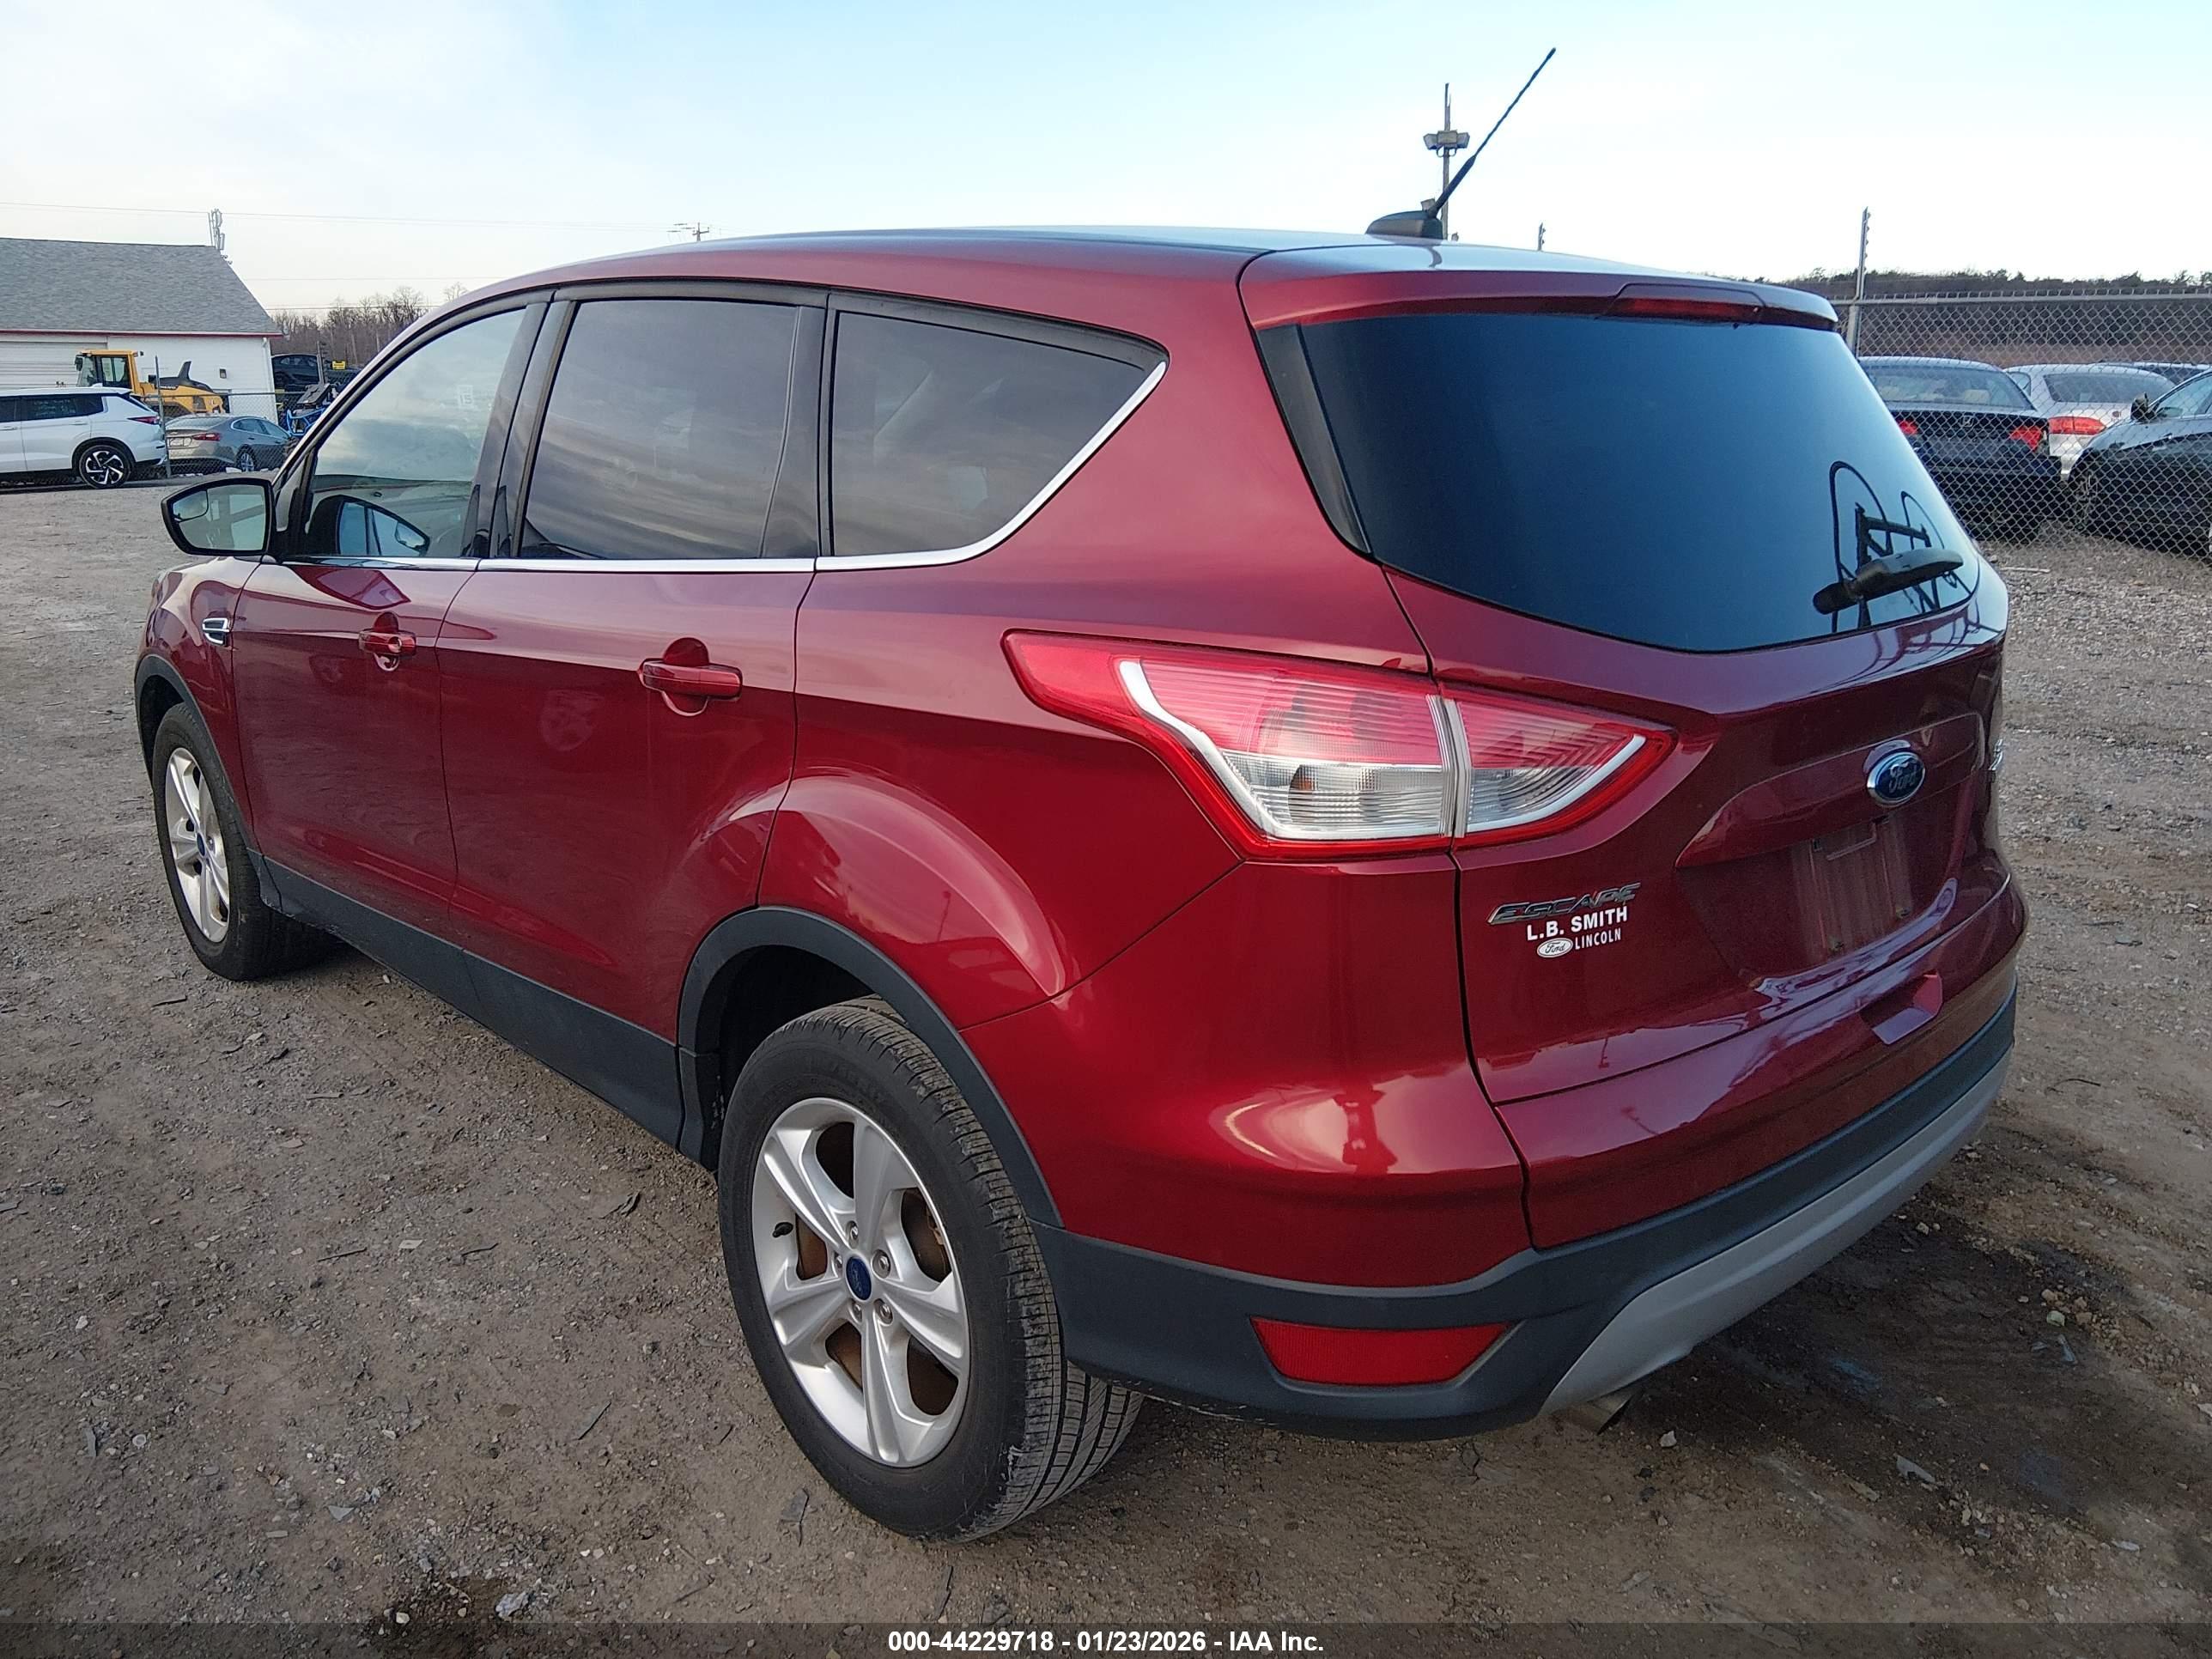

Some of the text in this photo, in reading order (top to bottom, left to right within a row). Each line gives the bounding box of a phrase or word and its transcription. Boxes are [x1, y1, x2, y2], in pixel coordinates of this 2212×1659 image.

[1487, 882, 1641, 925] ESCAPE
[1527, 906, 1627, 941] L.B. SMITH
[1575, 927, 1621, 951] LINCOLN
